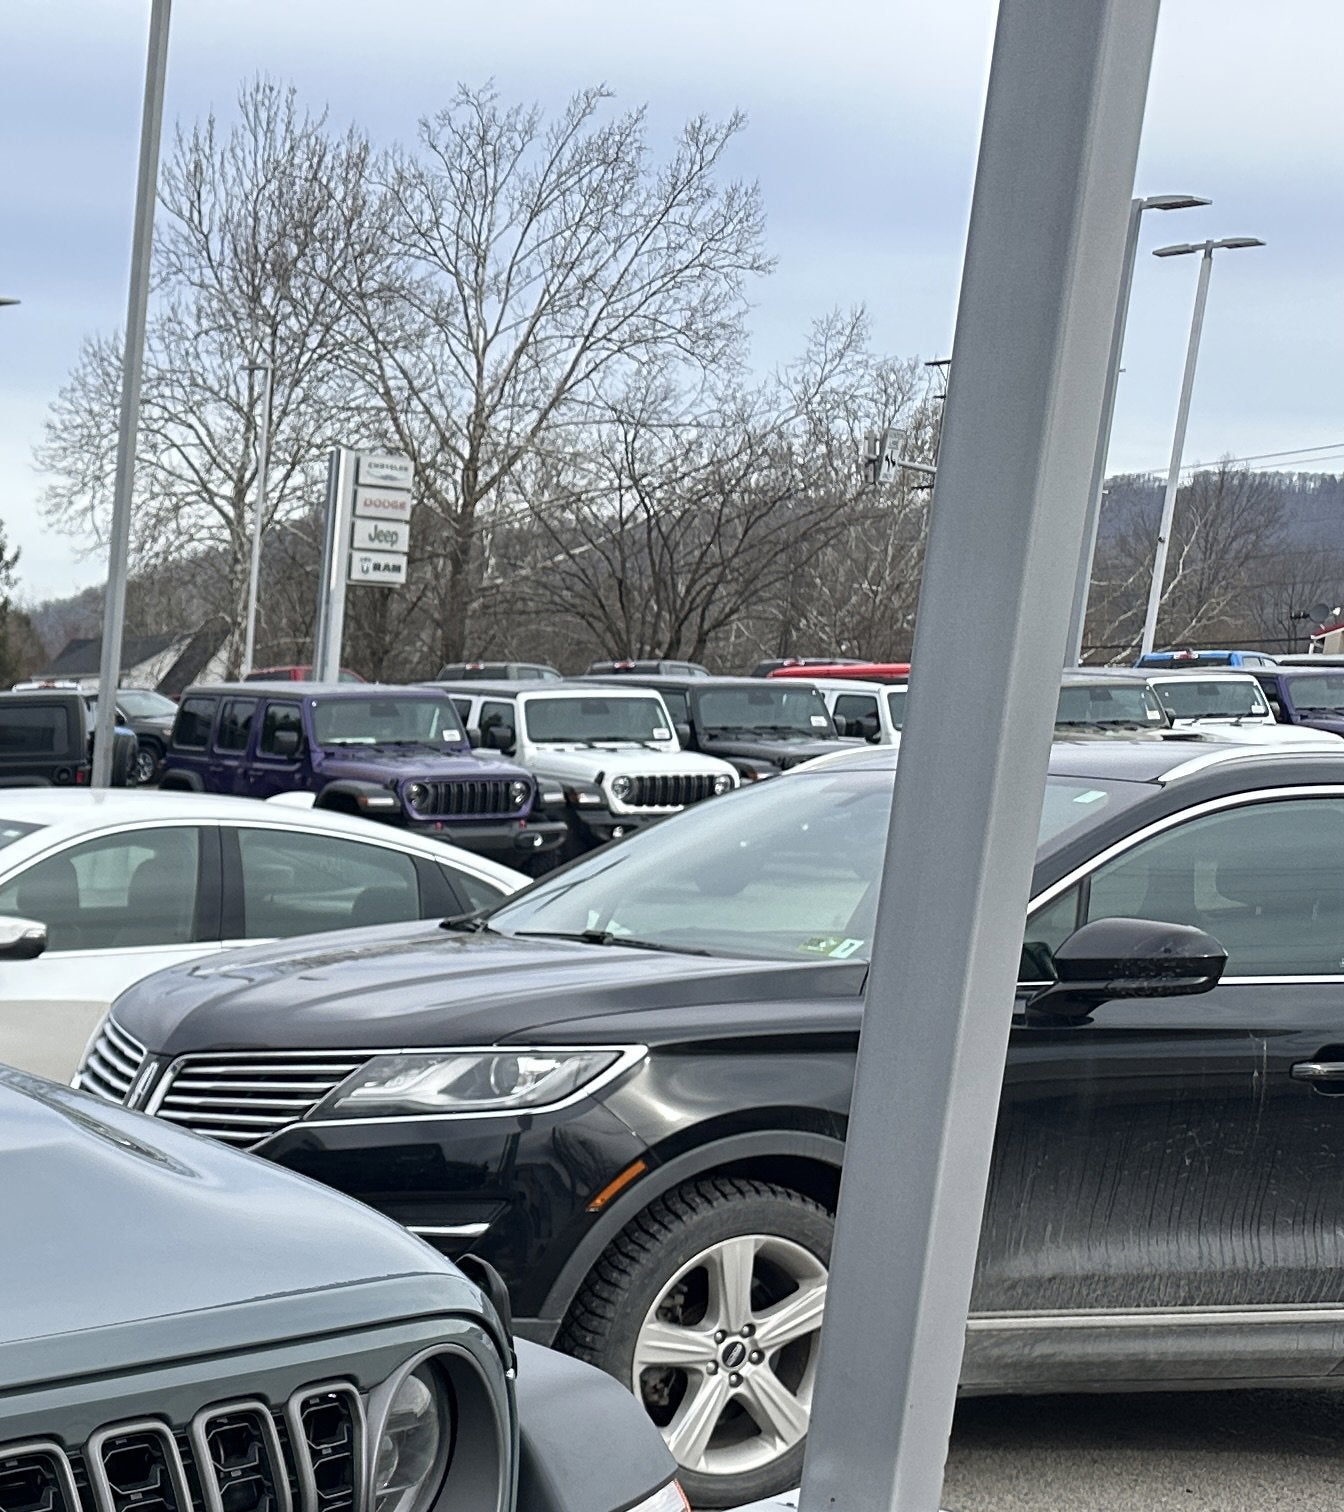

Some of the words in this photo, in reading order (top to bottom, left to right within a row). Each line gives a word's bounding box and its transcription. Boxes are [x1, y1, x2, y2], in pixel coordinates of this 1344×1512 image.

[367, 461, 409, 472] CHRYSLER
[363, 497, 407, 512] DODGE
[368, 523, 399, 548] Jeep
[372, 561, 402, 574] RAM
